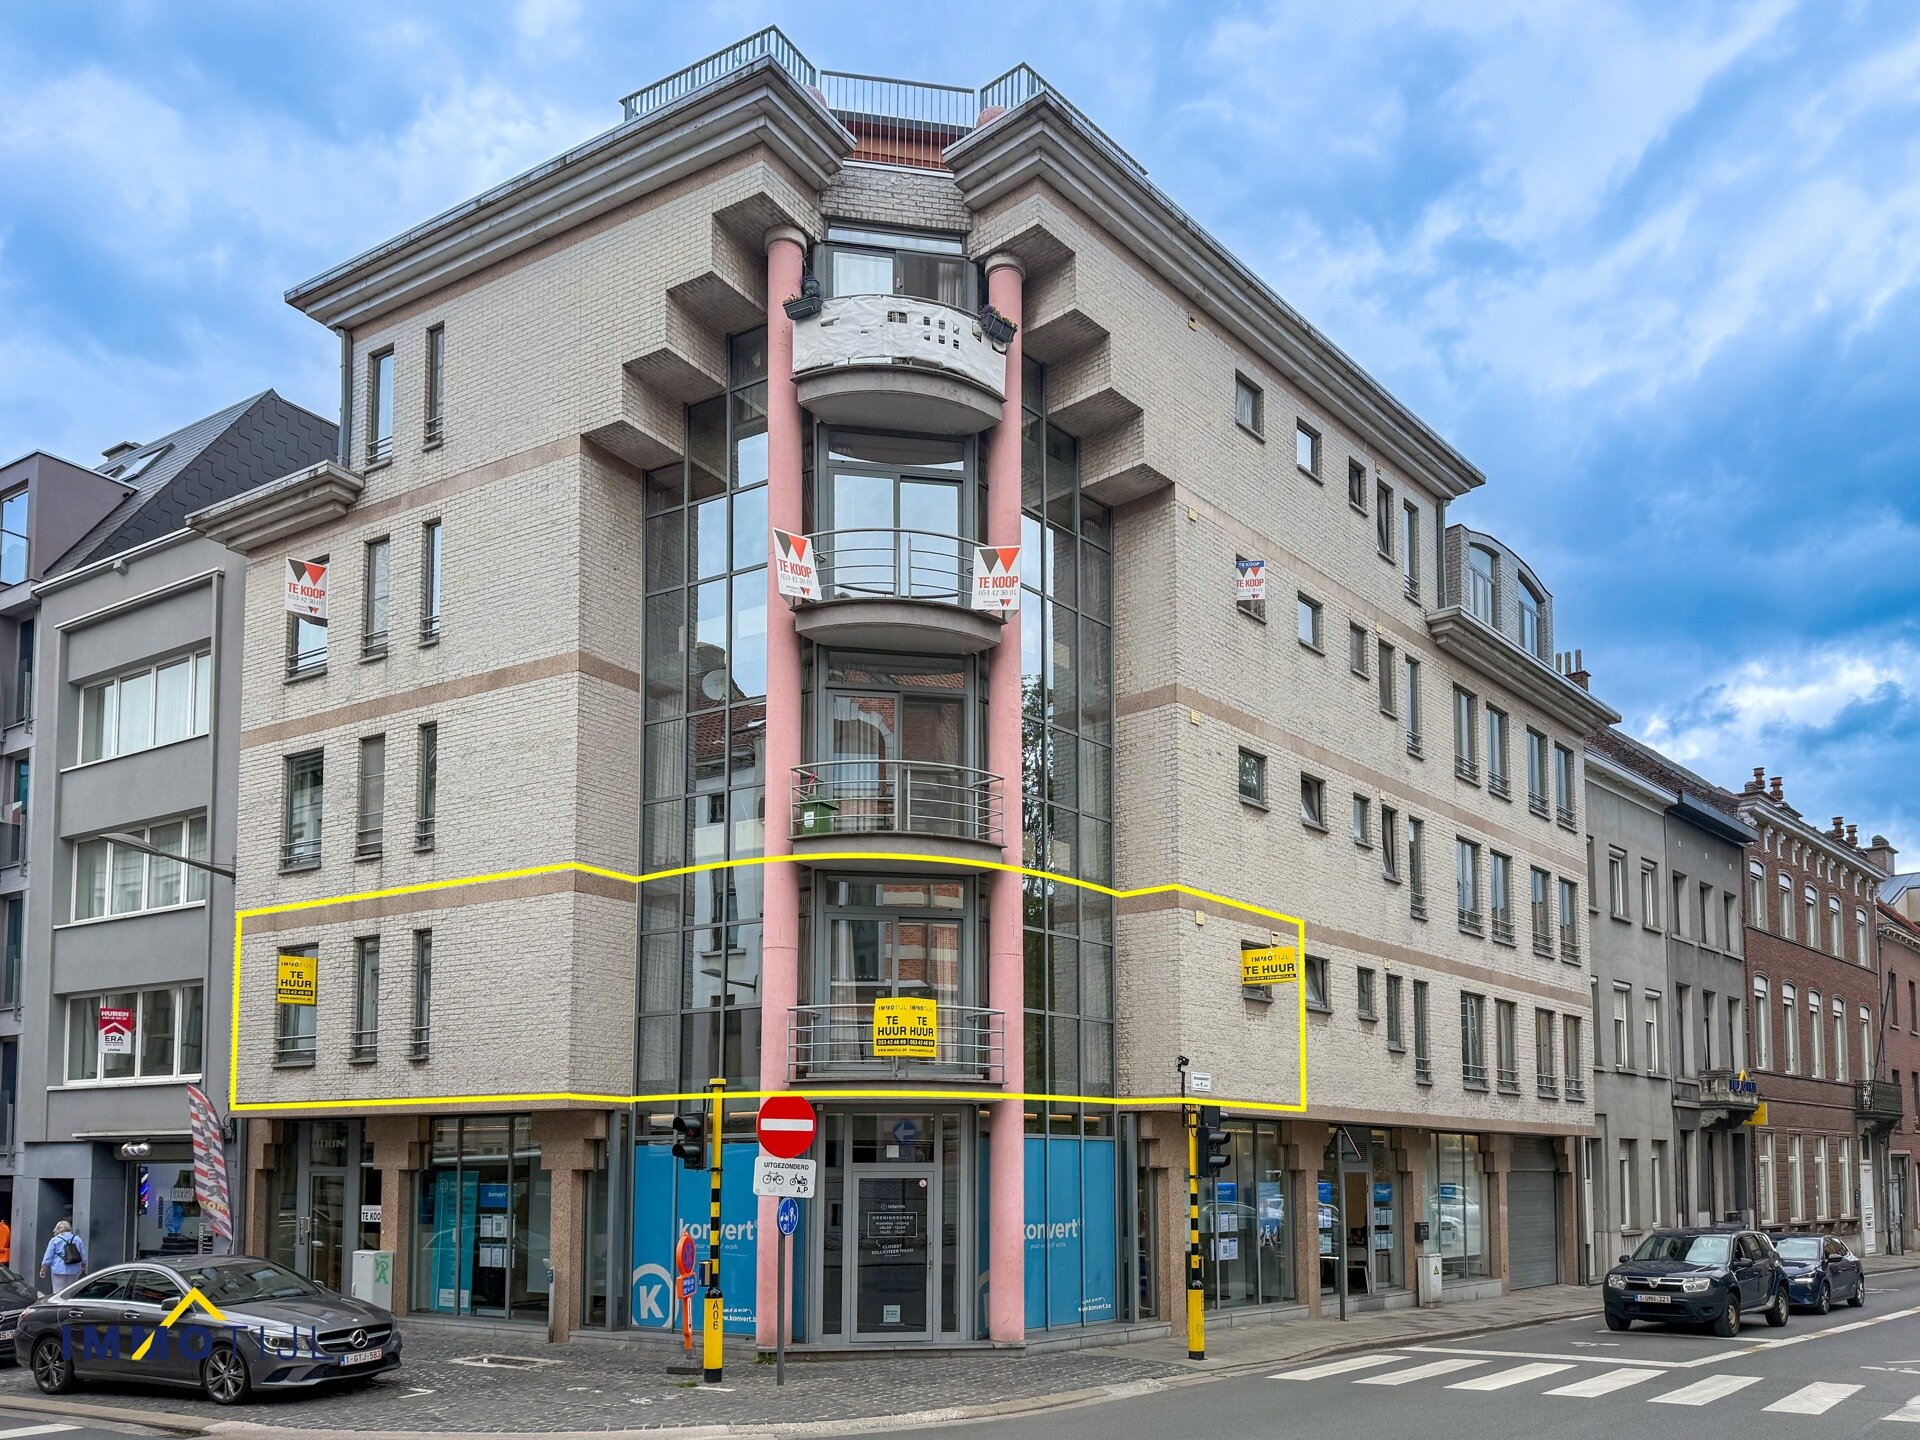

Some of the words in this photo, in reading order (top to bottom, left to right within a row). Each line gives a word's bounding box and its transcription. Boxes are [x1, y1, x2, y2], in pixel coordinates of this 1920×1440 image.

[778, 559, 789, 572] TE
[790, 562, 812, 578] KOOP
[978, 576, 990, 588] TE
[992, 576, 1018, 588] KOOP
[1236, 580, 1244, 588] TE
[1246, 579, 1264, 587] KOOP
[287, 582, 298, 594] TE
[301, 585, 326, 599] KOOP
[1244, 966, 1259, 974] TE
[1262, 963, 1295, 974] HUUR
[290, 971, 304, 979] TE
[281, 979, 312, 988] HUUR
[886, 1016, 898, 1025] TE
[917, 1016, 927, 1026] TE
[878, 1027, 906, 1036] HUUR
[910, 1027, 933, 1037] HUUR
[764, 1162, 809, 1170] UITGEZONDERD
[362, 1212, 369, 1220] TE
[370, 1212, 381, 1220] KOO
